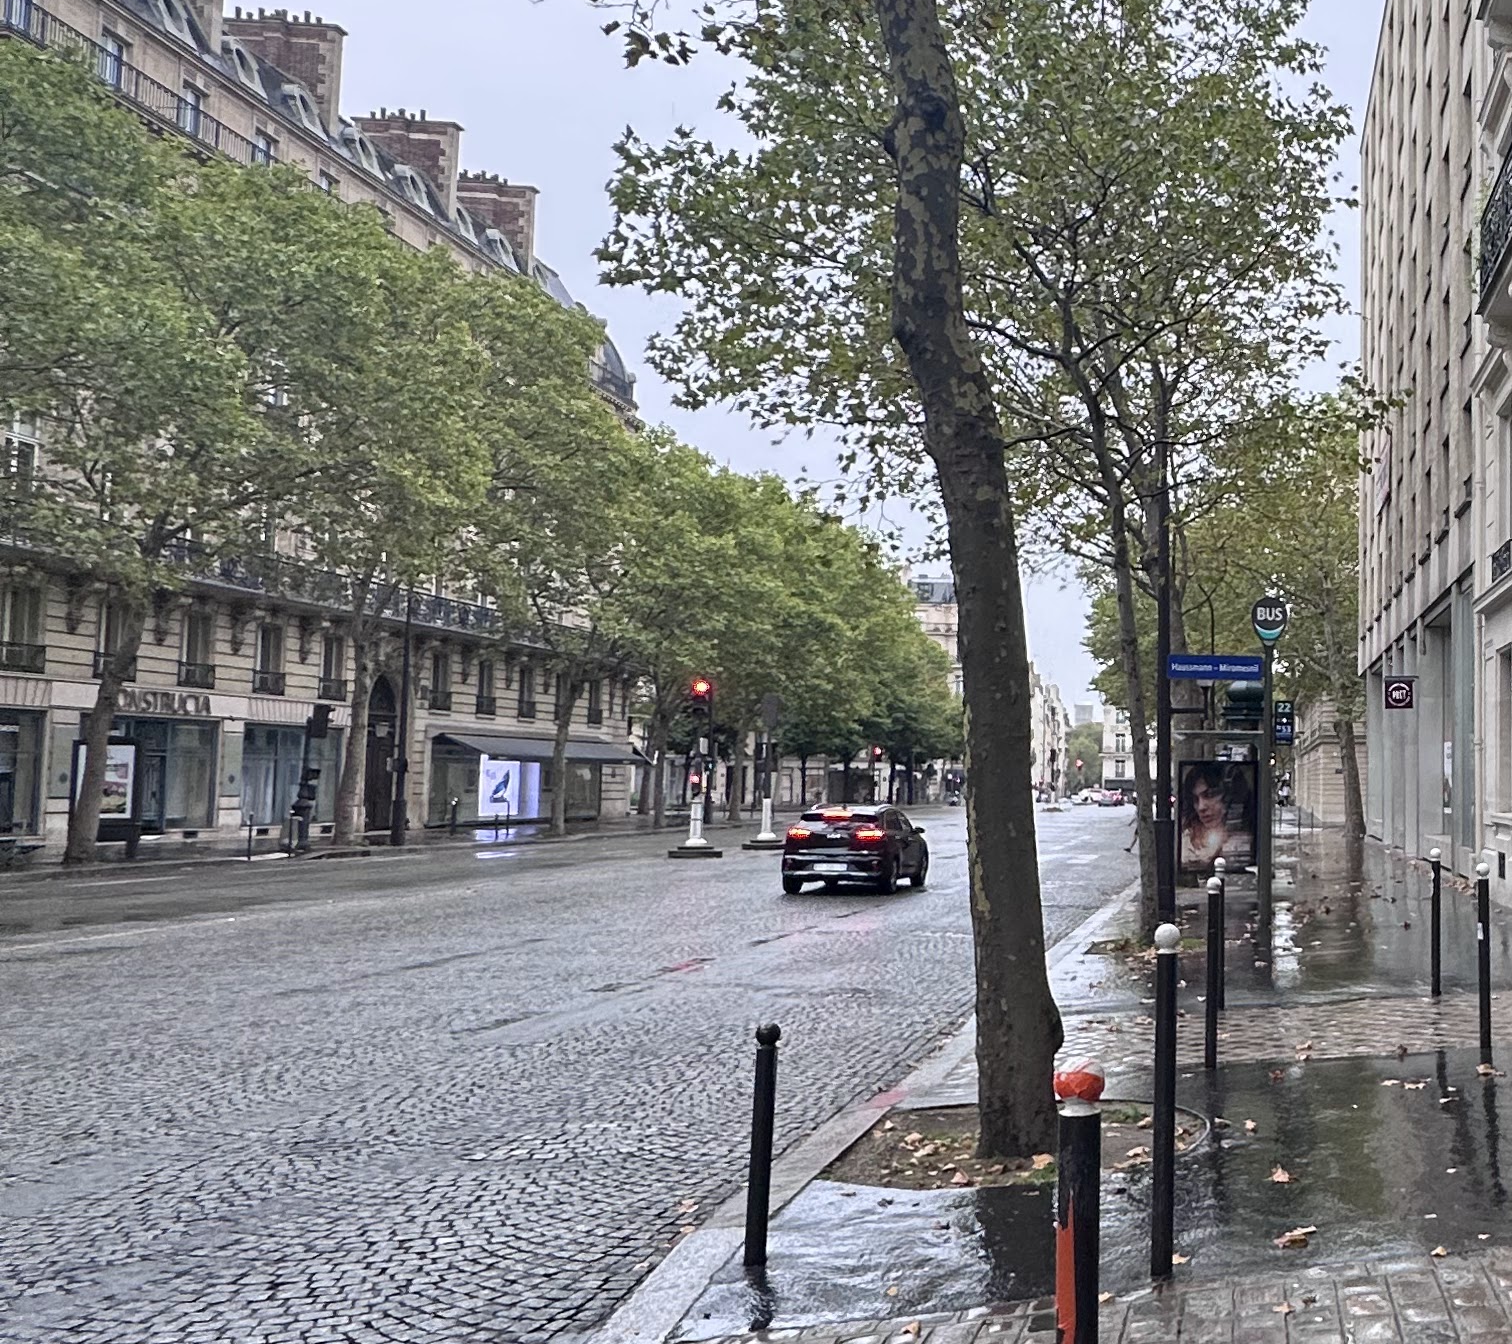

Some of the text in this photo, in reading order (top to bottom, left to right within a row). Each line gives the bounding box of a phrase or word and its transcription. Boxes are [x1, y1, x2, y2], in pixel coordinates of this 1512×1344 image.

[1256, 606, 1283, 621] BUS
[115, 687, 212, 715] ONSTRUCTA
[1277, 702, 1292, 713] 22
